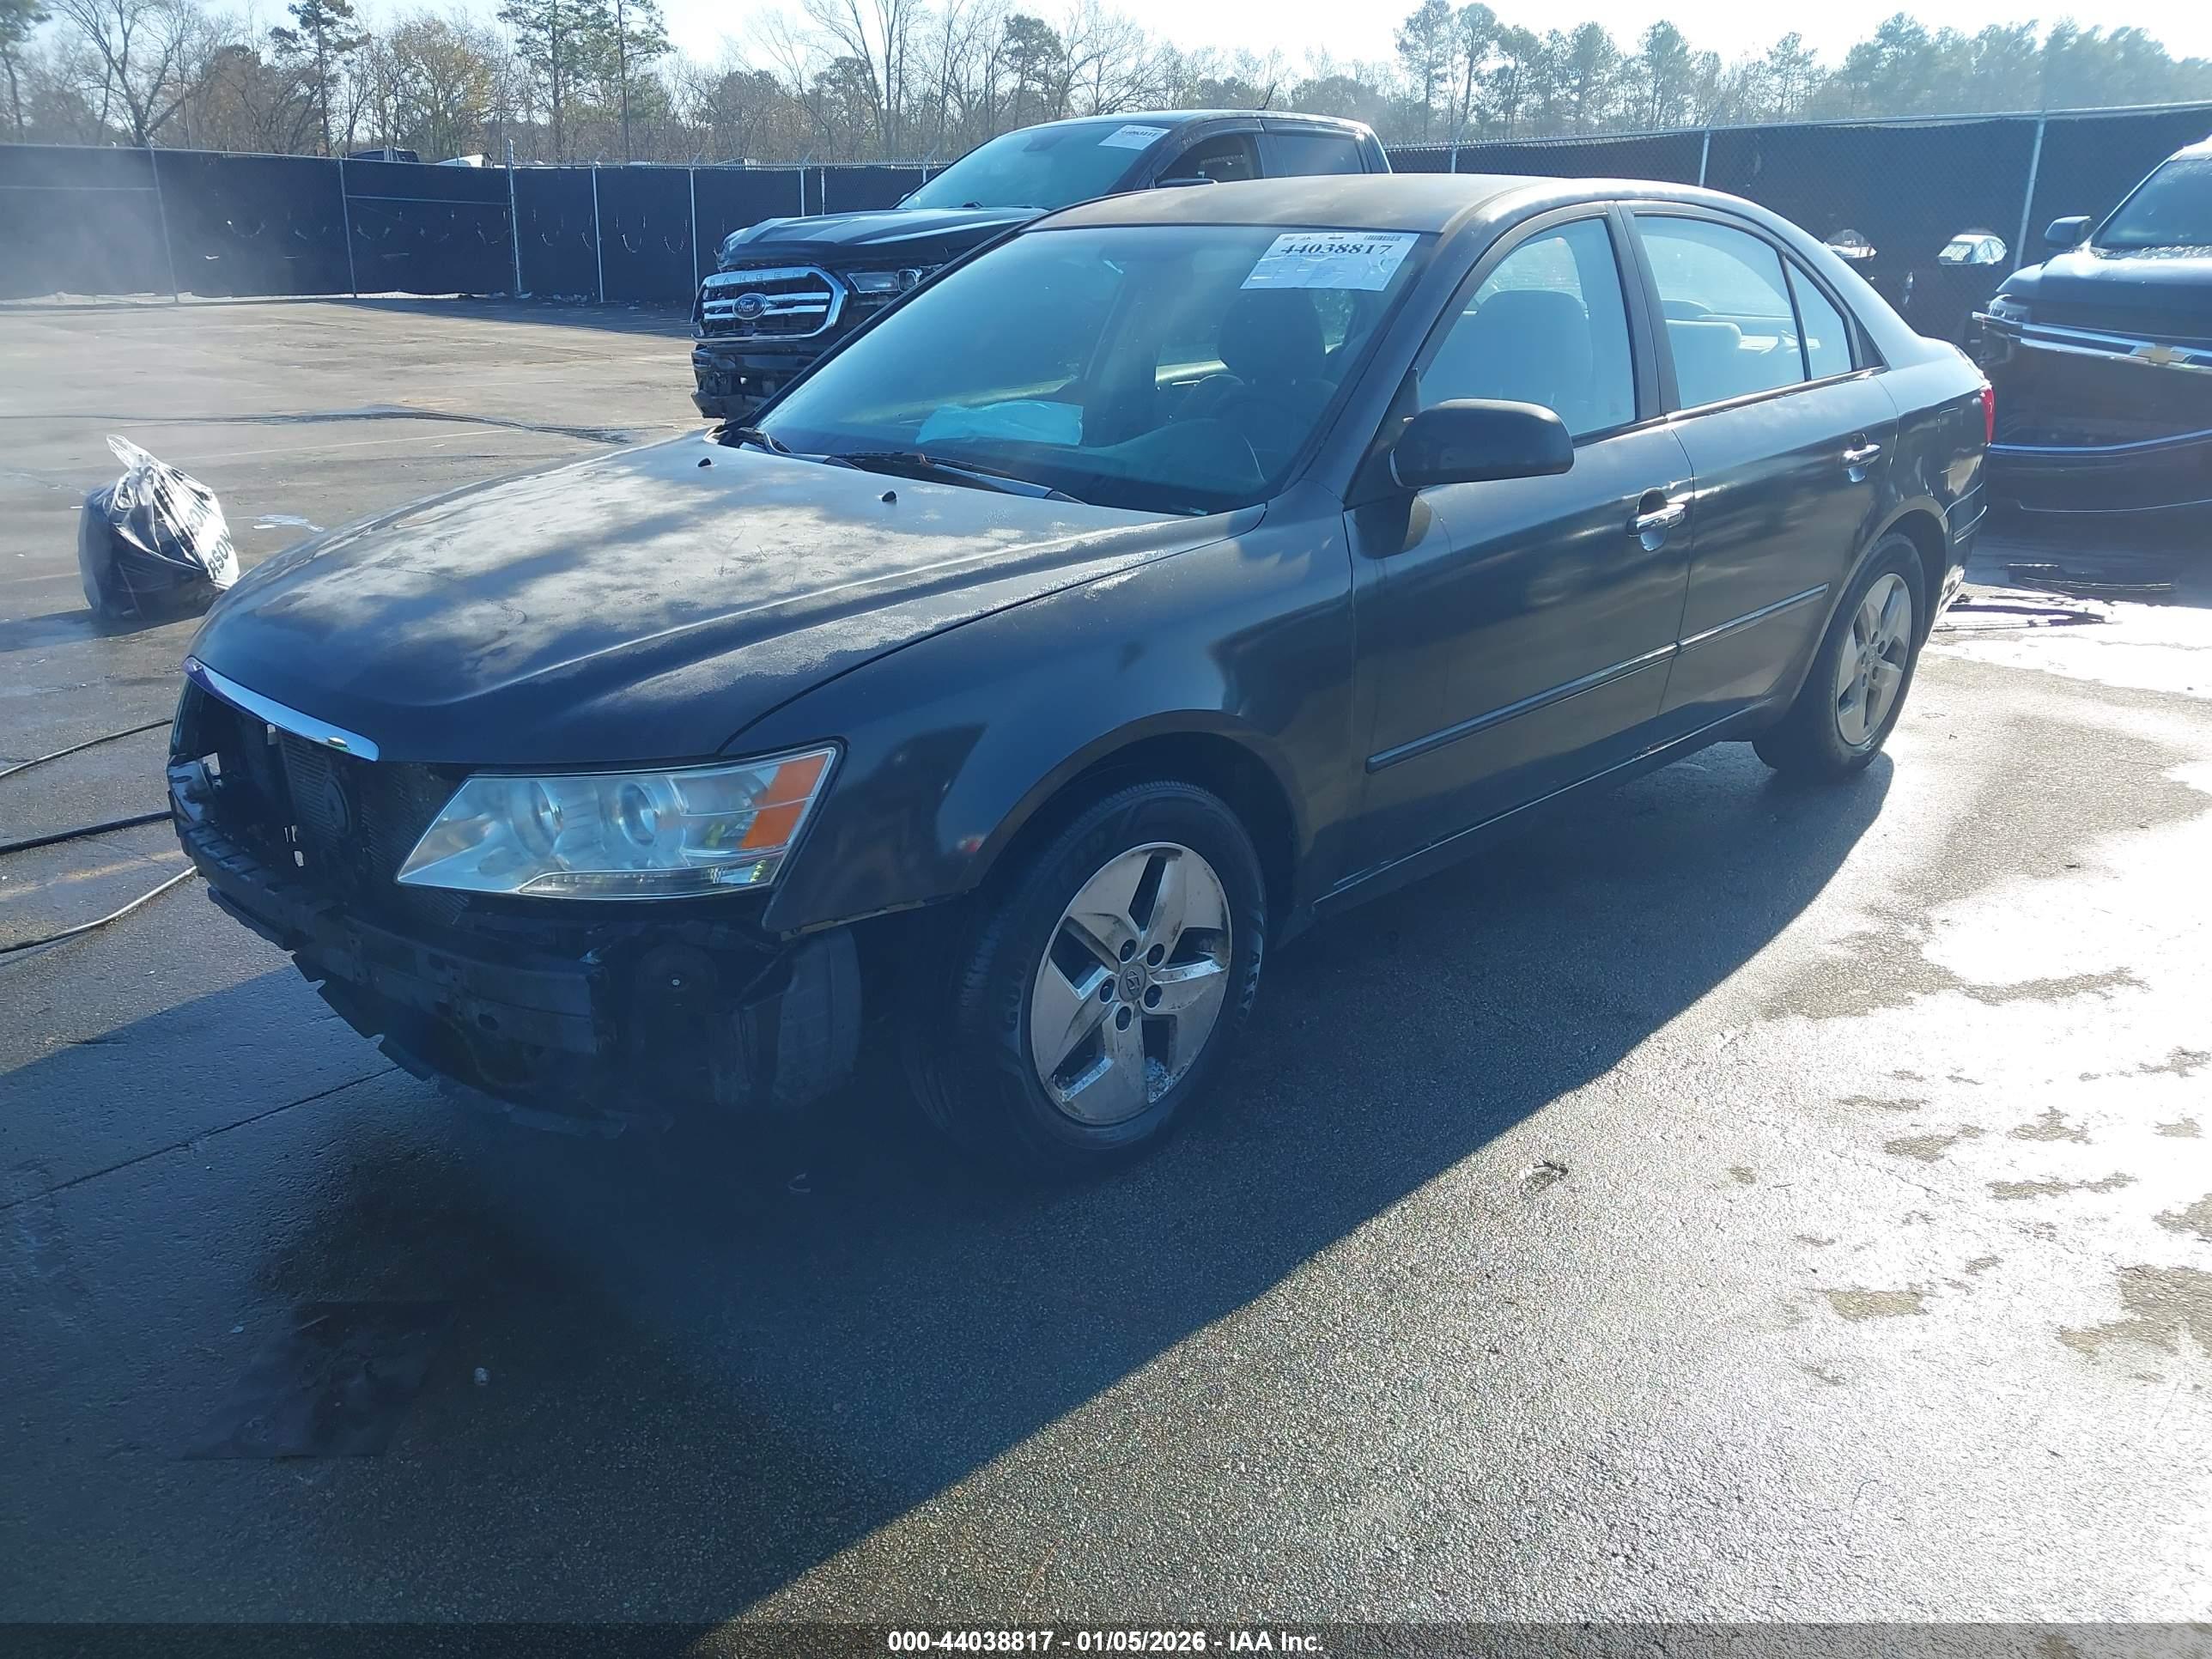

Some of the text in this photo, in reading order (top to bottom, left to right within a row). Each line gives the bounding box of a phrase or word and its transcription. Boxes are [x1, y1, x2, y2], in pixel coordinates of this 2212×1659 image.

[1280, 243, 1394, 255] 44038817
[708, 268, 803, 287] RANGER
[738, 299, 755, 313] Ford
